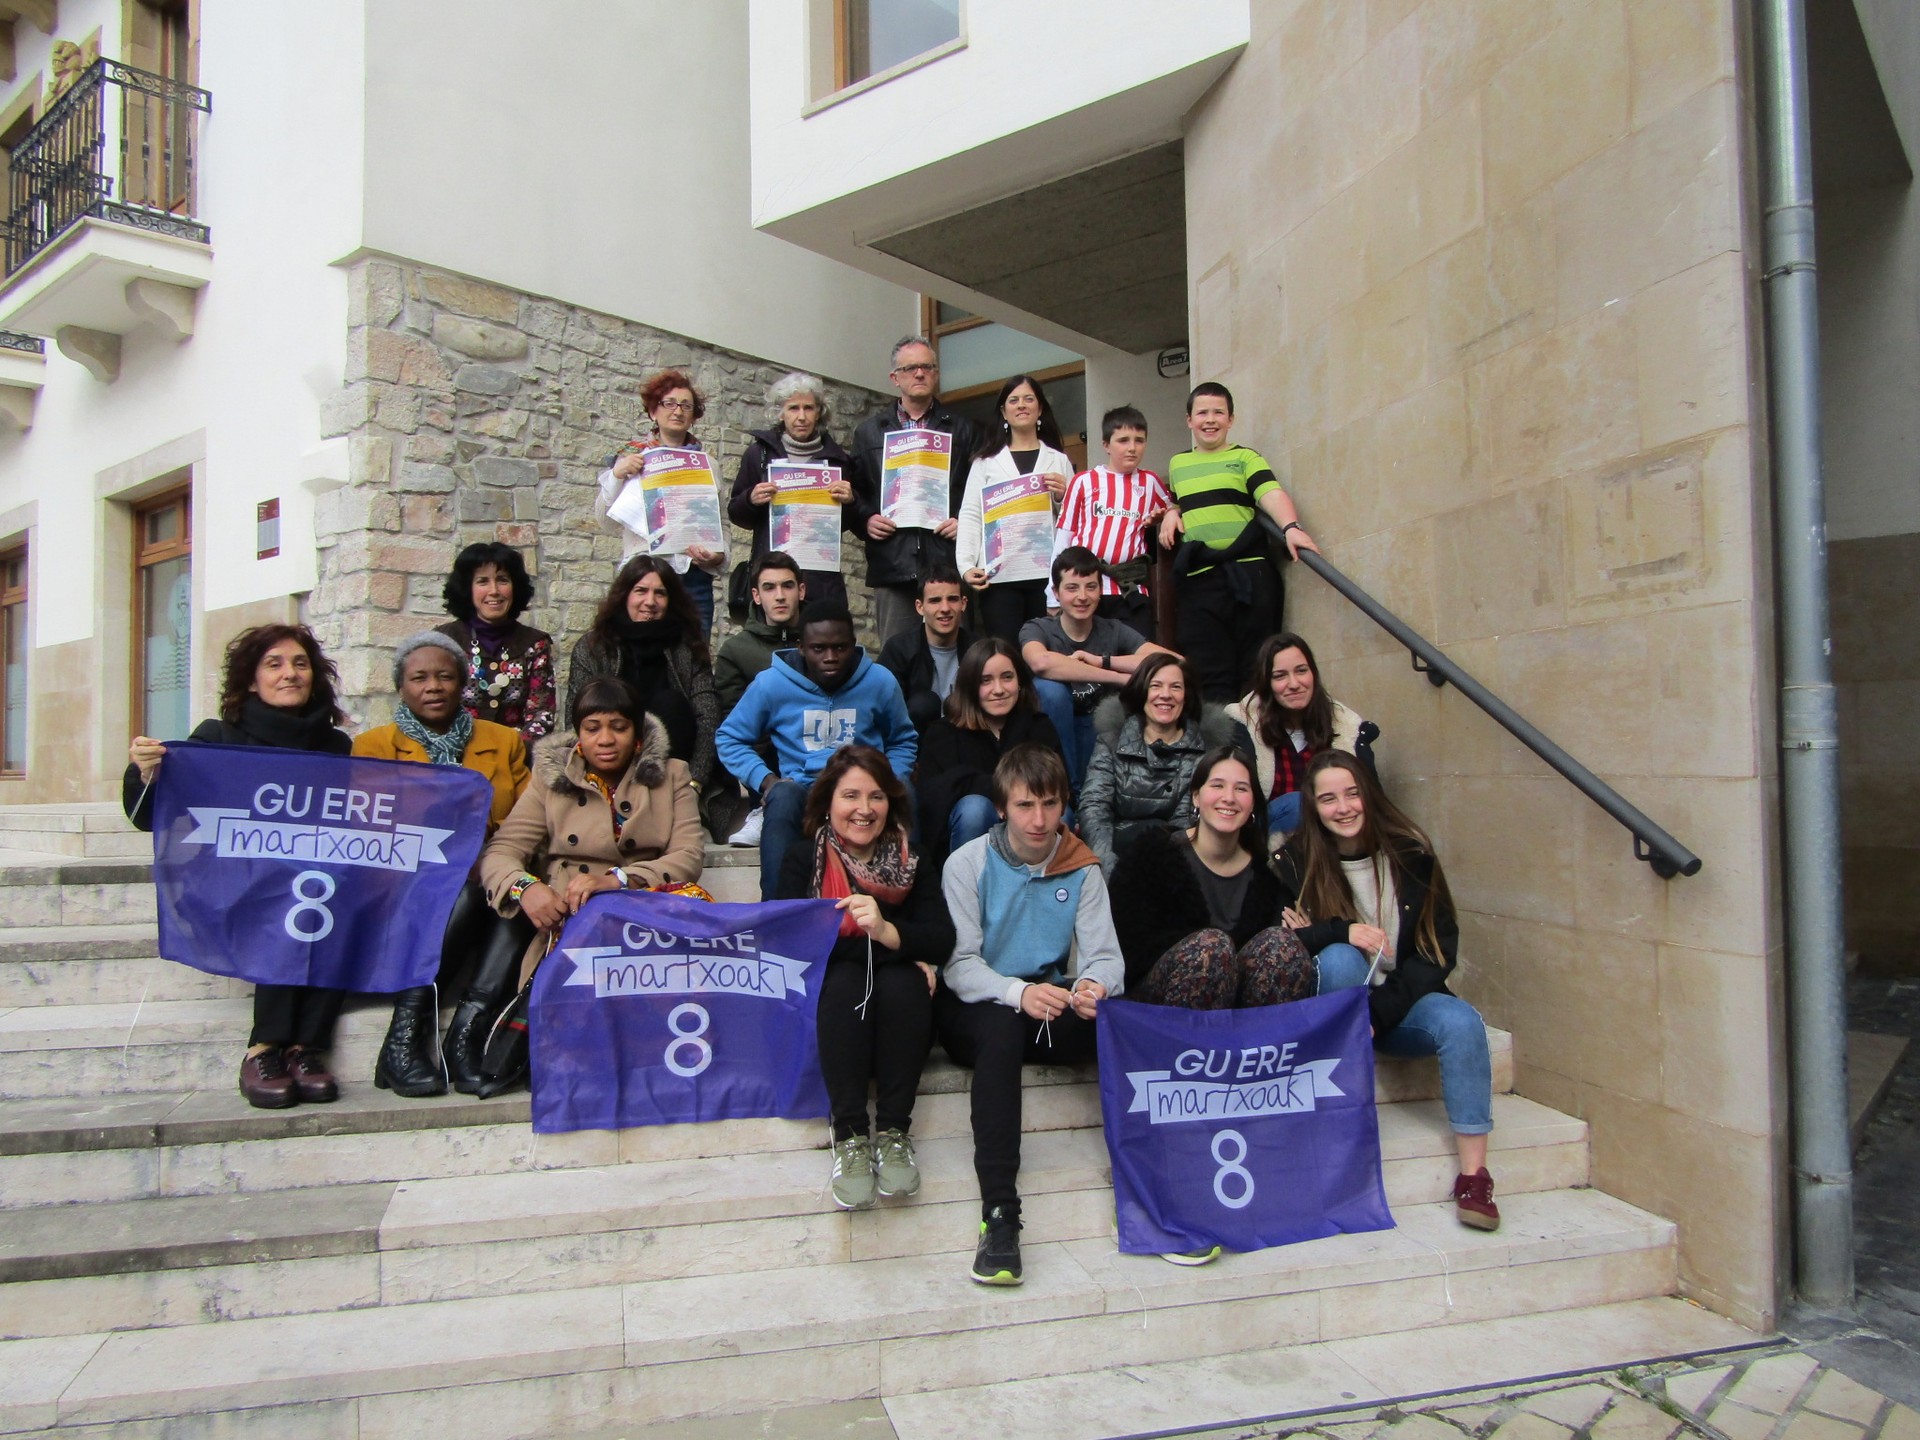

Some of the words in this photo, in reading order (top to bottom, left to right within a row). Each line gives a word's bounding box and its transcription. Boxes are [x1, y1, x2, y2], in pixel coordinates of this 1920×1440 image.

[689, 453, 701, 466] 8
[933, 434, 942, 448] 8
[822, 470, 832, 484] 8
[1029, 475, 1040, 490] 8
[1094, 501, 1140, 518] Kutxabank
[253, 783, 314, 818] GU
[321, 787, 397, 826] ERE
[230, 825, 407, 867] martxoak
[284, 870, 336, 942] 8
[606, 954, 775, 994] martxoak
[664, 1002, 713, 1077] 8
[1175, 1049, 1231, 1078] GU
[1236, 1042, 1299, 1078] ERE
[1158, 1073, 1304, 1117] martxoak
[1210, 1129, 1255, 1209] 8
